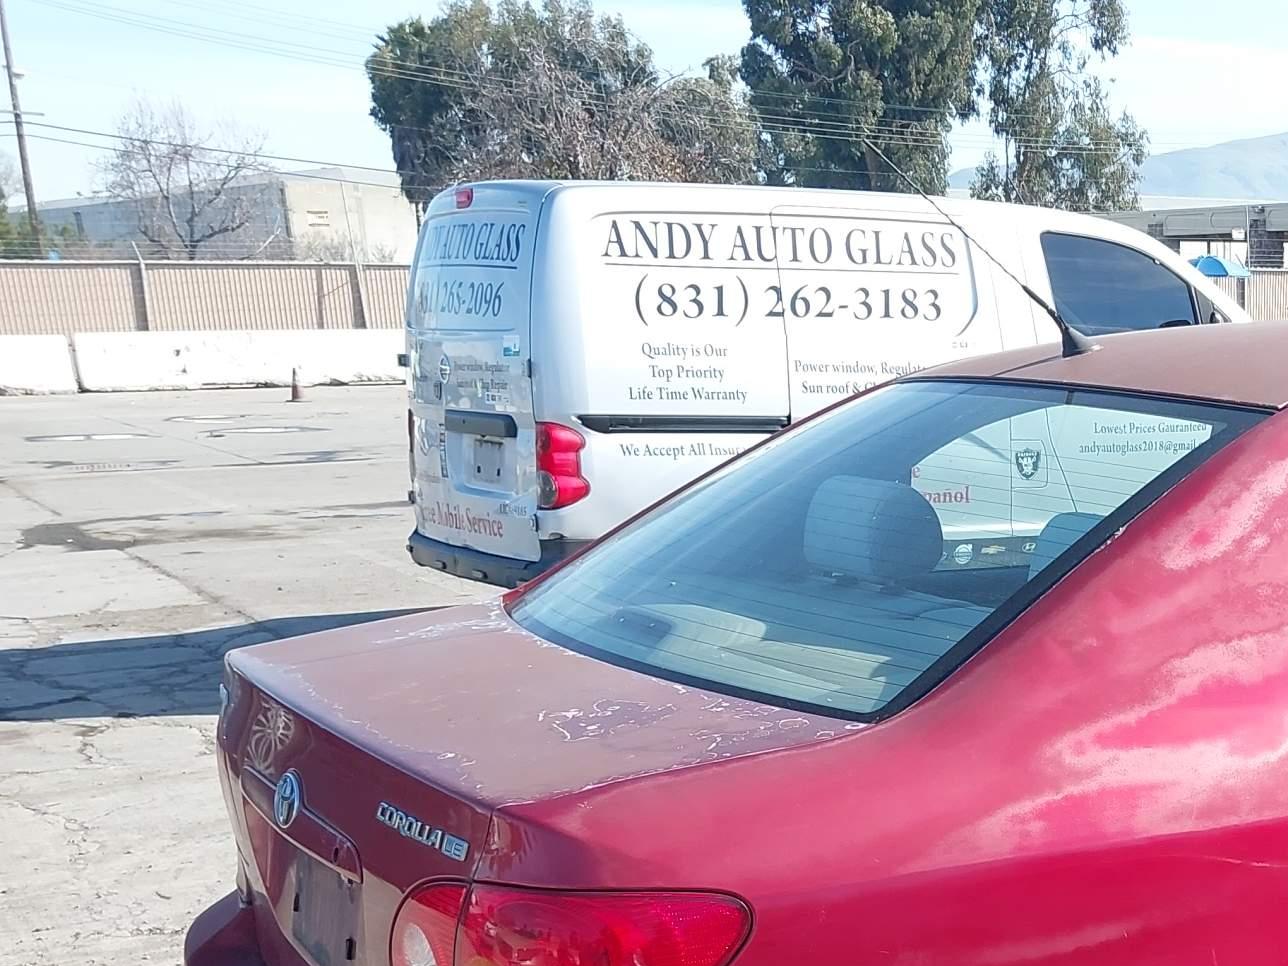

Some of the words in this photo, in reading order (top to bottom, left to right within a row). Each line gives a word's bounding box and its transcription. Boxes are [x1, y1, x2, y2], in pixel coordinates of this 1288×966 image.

[474, 222, 526, 262] GLASS
[601, 219, 719, 261] ANDY
[727, 224, 833, 264] AUTO
[845, 228, 957, 268] GLASS
[440, 279, 505, 318] 265-2096
[634, 273, 750, 327] (831)
[763, 283, 943, 322] 262-3183
[641, 341, 688, 361] Quality
[691, 343, 701, 357] is
[704, 343, 728, 357] Our
[648, 364, 673, 383] Top
[676, 364, 725, 383] Priority
[794, 359, 830, 373] Power
[832, 360, 879, 376] window,
[628, 384, 653, 401] Life
[656, 385, 689, 401] Time
[691, 386, 748, 405] Warranty
[801, 380, 825, 394] Sun
[826, 380, 850, 394] roof
[851, 382, 863, 395] &
[1093, 421, 1128, 434] Lowest
[1129, 422, 1156, 434] Prices
[619, 442, 640, 457] We
[643, 443, 686, 461] Accept
[688, 443, 706, 456] All
[463, 507, 504, 538] Service
[376, 801, 443, 850] COROLLA
[442, 833, 470, 861] LE
